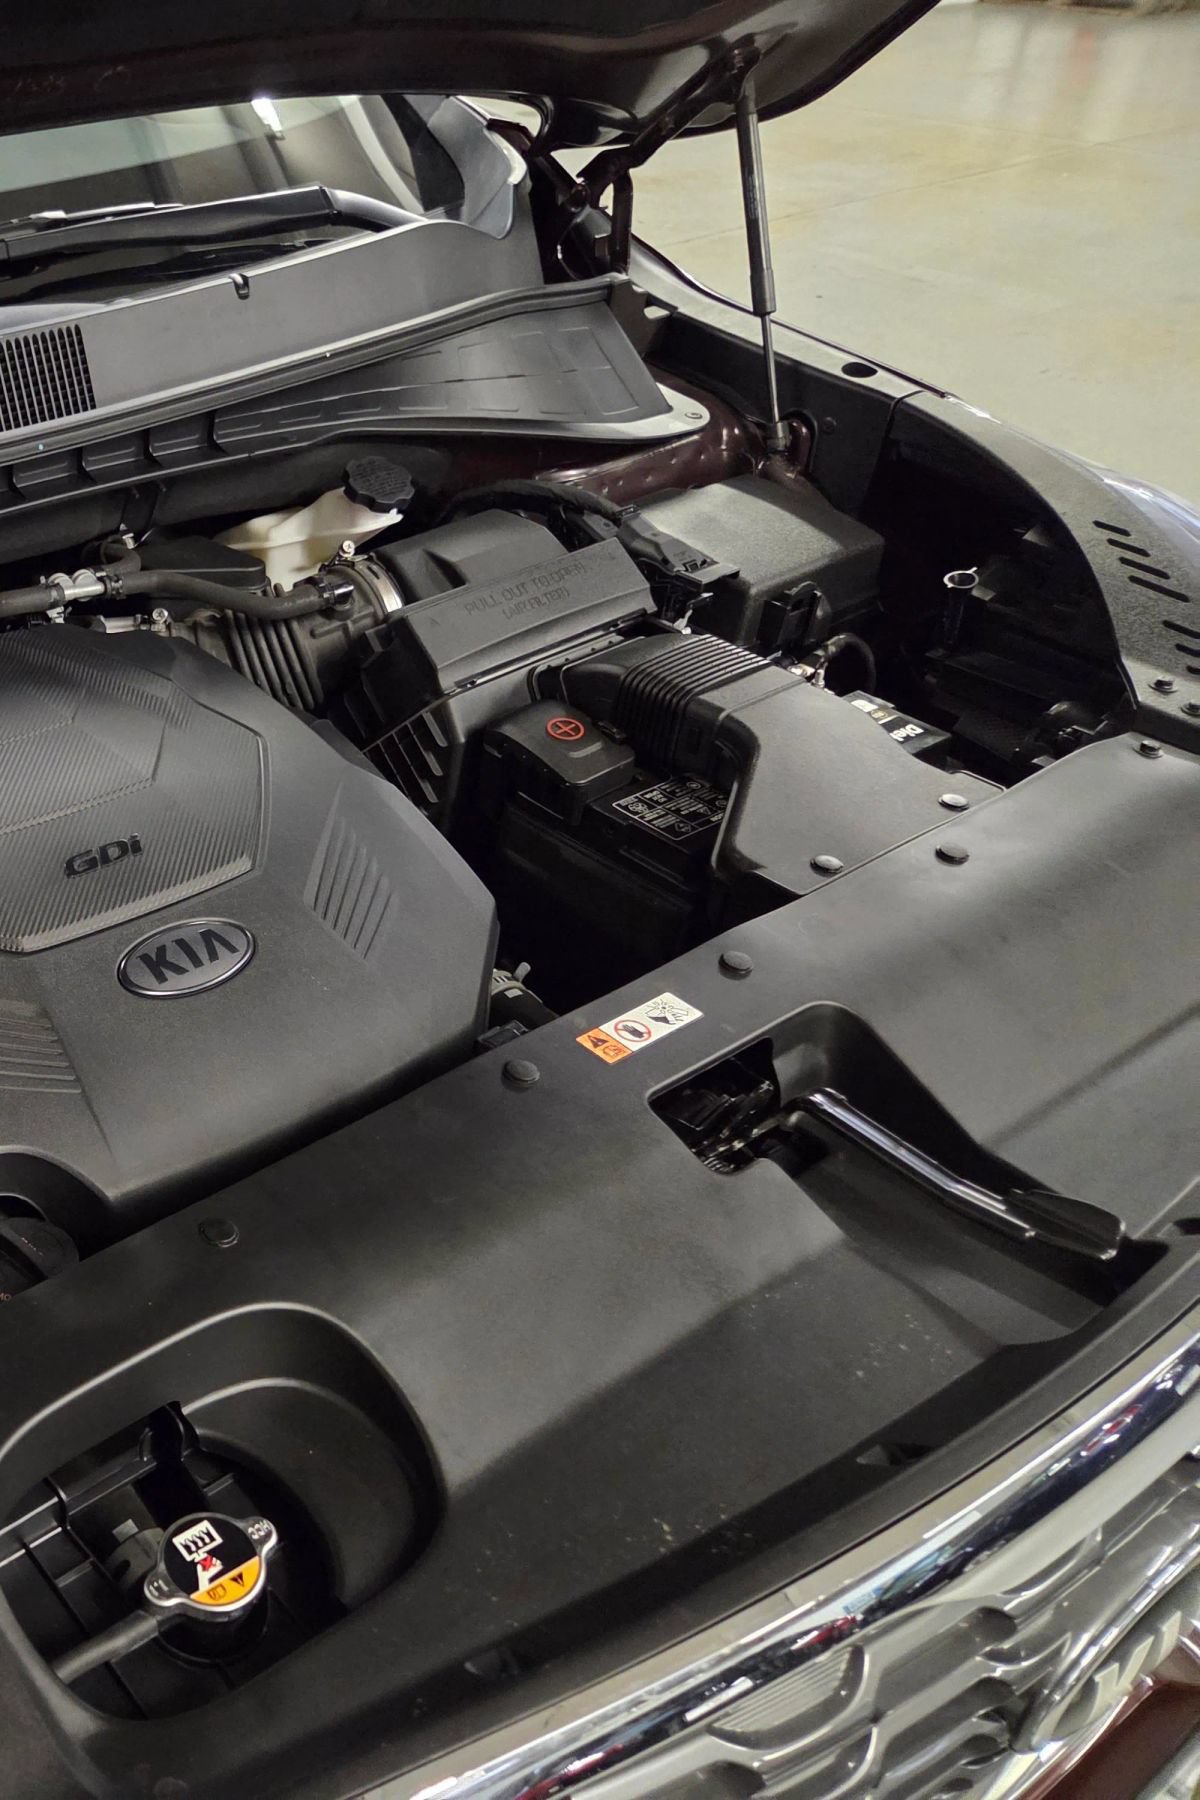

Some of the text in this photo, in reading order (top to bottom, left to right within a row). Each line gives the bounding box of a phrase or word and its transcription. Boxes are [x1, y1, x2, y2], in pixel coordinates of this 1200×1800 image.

[465, 594, 502, 617] PULL
[502, 582, 530, 603] OUT
[531, 574, 551, 596] TO
[136, 928, 240, 985] KIA
